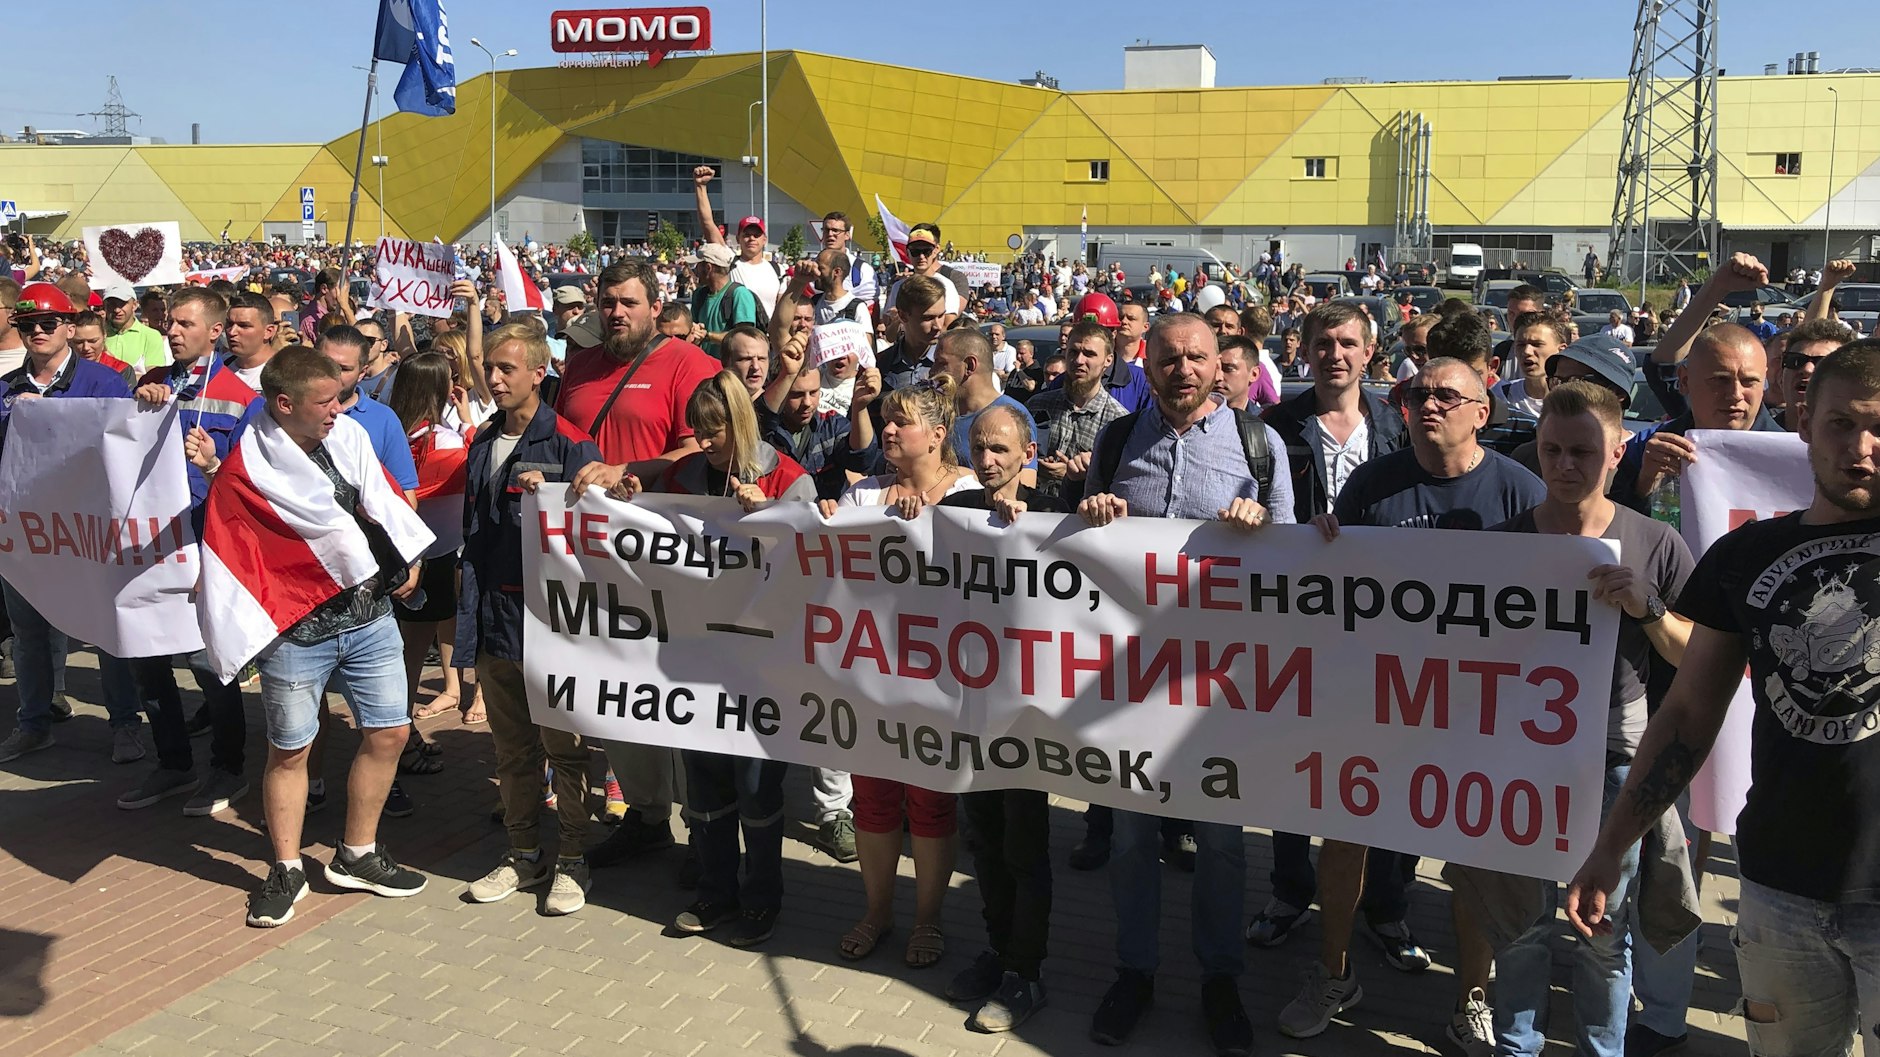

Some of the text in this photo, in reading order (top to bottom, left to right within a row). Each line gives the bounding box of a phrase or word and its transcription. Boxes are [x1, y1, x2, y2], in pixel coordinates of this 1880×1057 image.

[609, 59, 641, 68] ЦЕНТР
[374, 277, 456, 311] УХОДИ
[18, 511, 188, 566] ВАМИ!!!
[538, 511, 1591, 645] НЕовцы, НЕбыдло, НЕнародец
[546, 580, 669, 643] МЫ
[804, 603, 1313, 718] РАБОТНИКИ
[1375, 653, 1580, 745] МТЗ
[1822, 718, 1855, 741] OF
[547, 674, 1570, 853] и нас не 20 человек, а 16 000!
